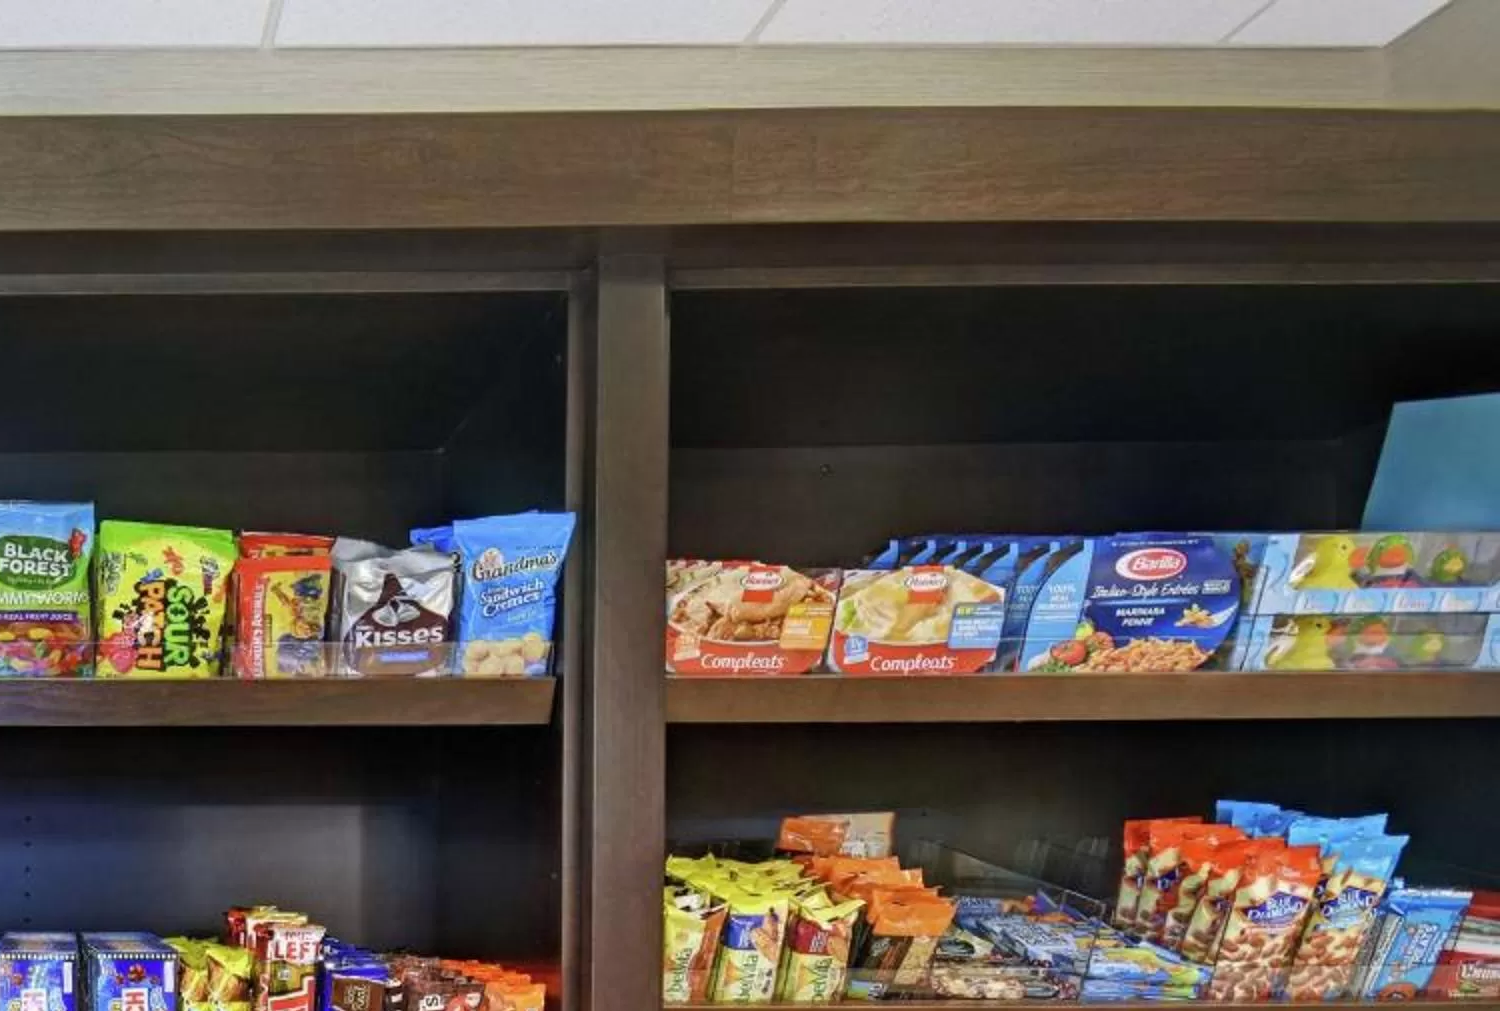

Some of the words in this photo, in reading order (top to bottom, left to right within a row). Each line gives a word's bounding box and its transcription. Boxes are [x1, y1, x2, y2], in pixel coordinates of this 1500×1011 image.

[4, 543, 69, 564] BLACK
[1132, 554, 1182, 575] Barilla
[163, 584, 195, 667] SOUR
[700, 652, 787, 674] Compleats
[869, 654, 957, 677] Compleats
